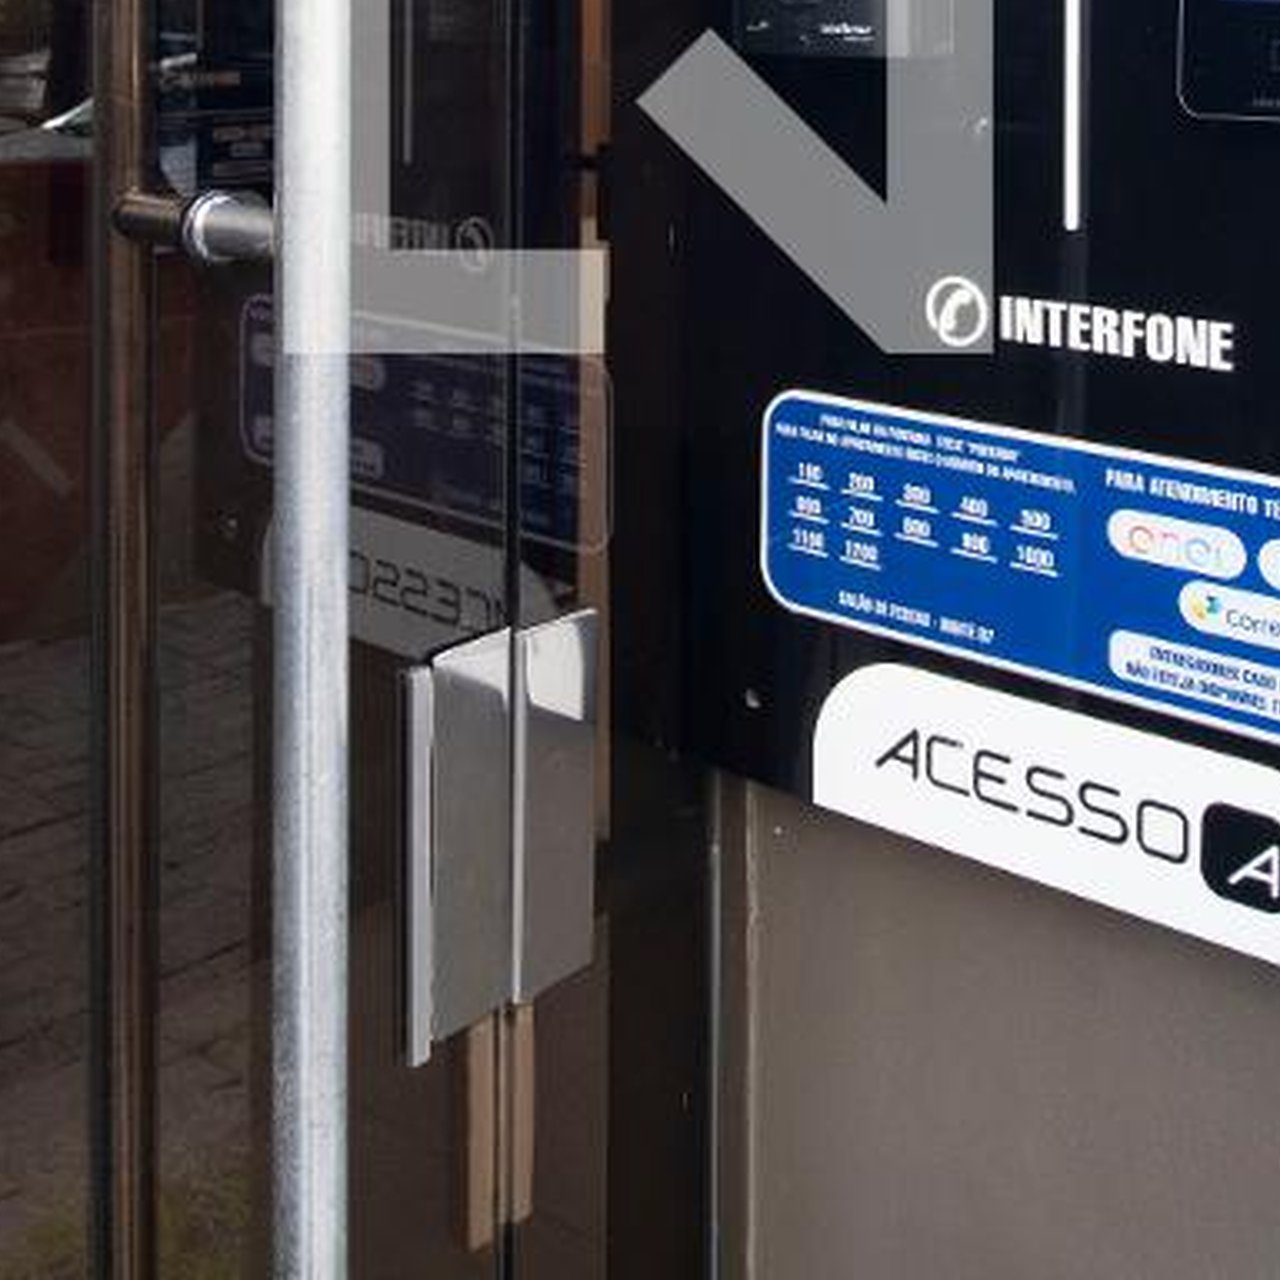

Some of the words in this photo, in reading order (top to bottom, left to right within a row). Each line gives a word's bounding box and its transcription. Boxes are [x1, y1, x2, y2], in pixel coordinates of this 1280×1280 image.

[1000, 296, 1234, 371] INTERFONE
[1105, 469, 1145, 494] PARA
[875, 729, 1191, 866] ACESSO
